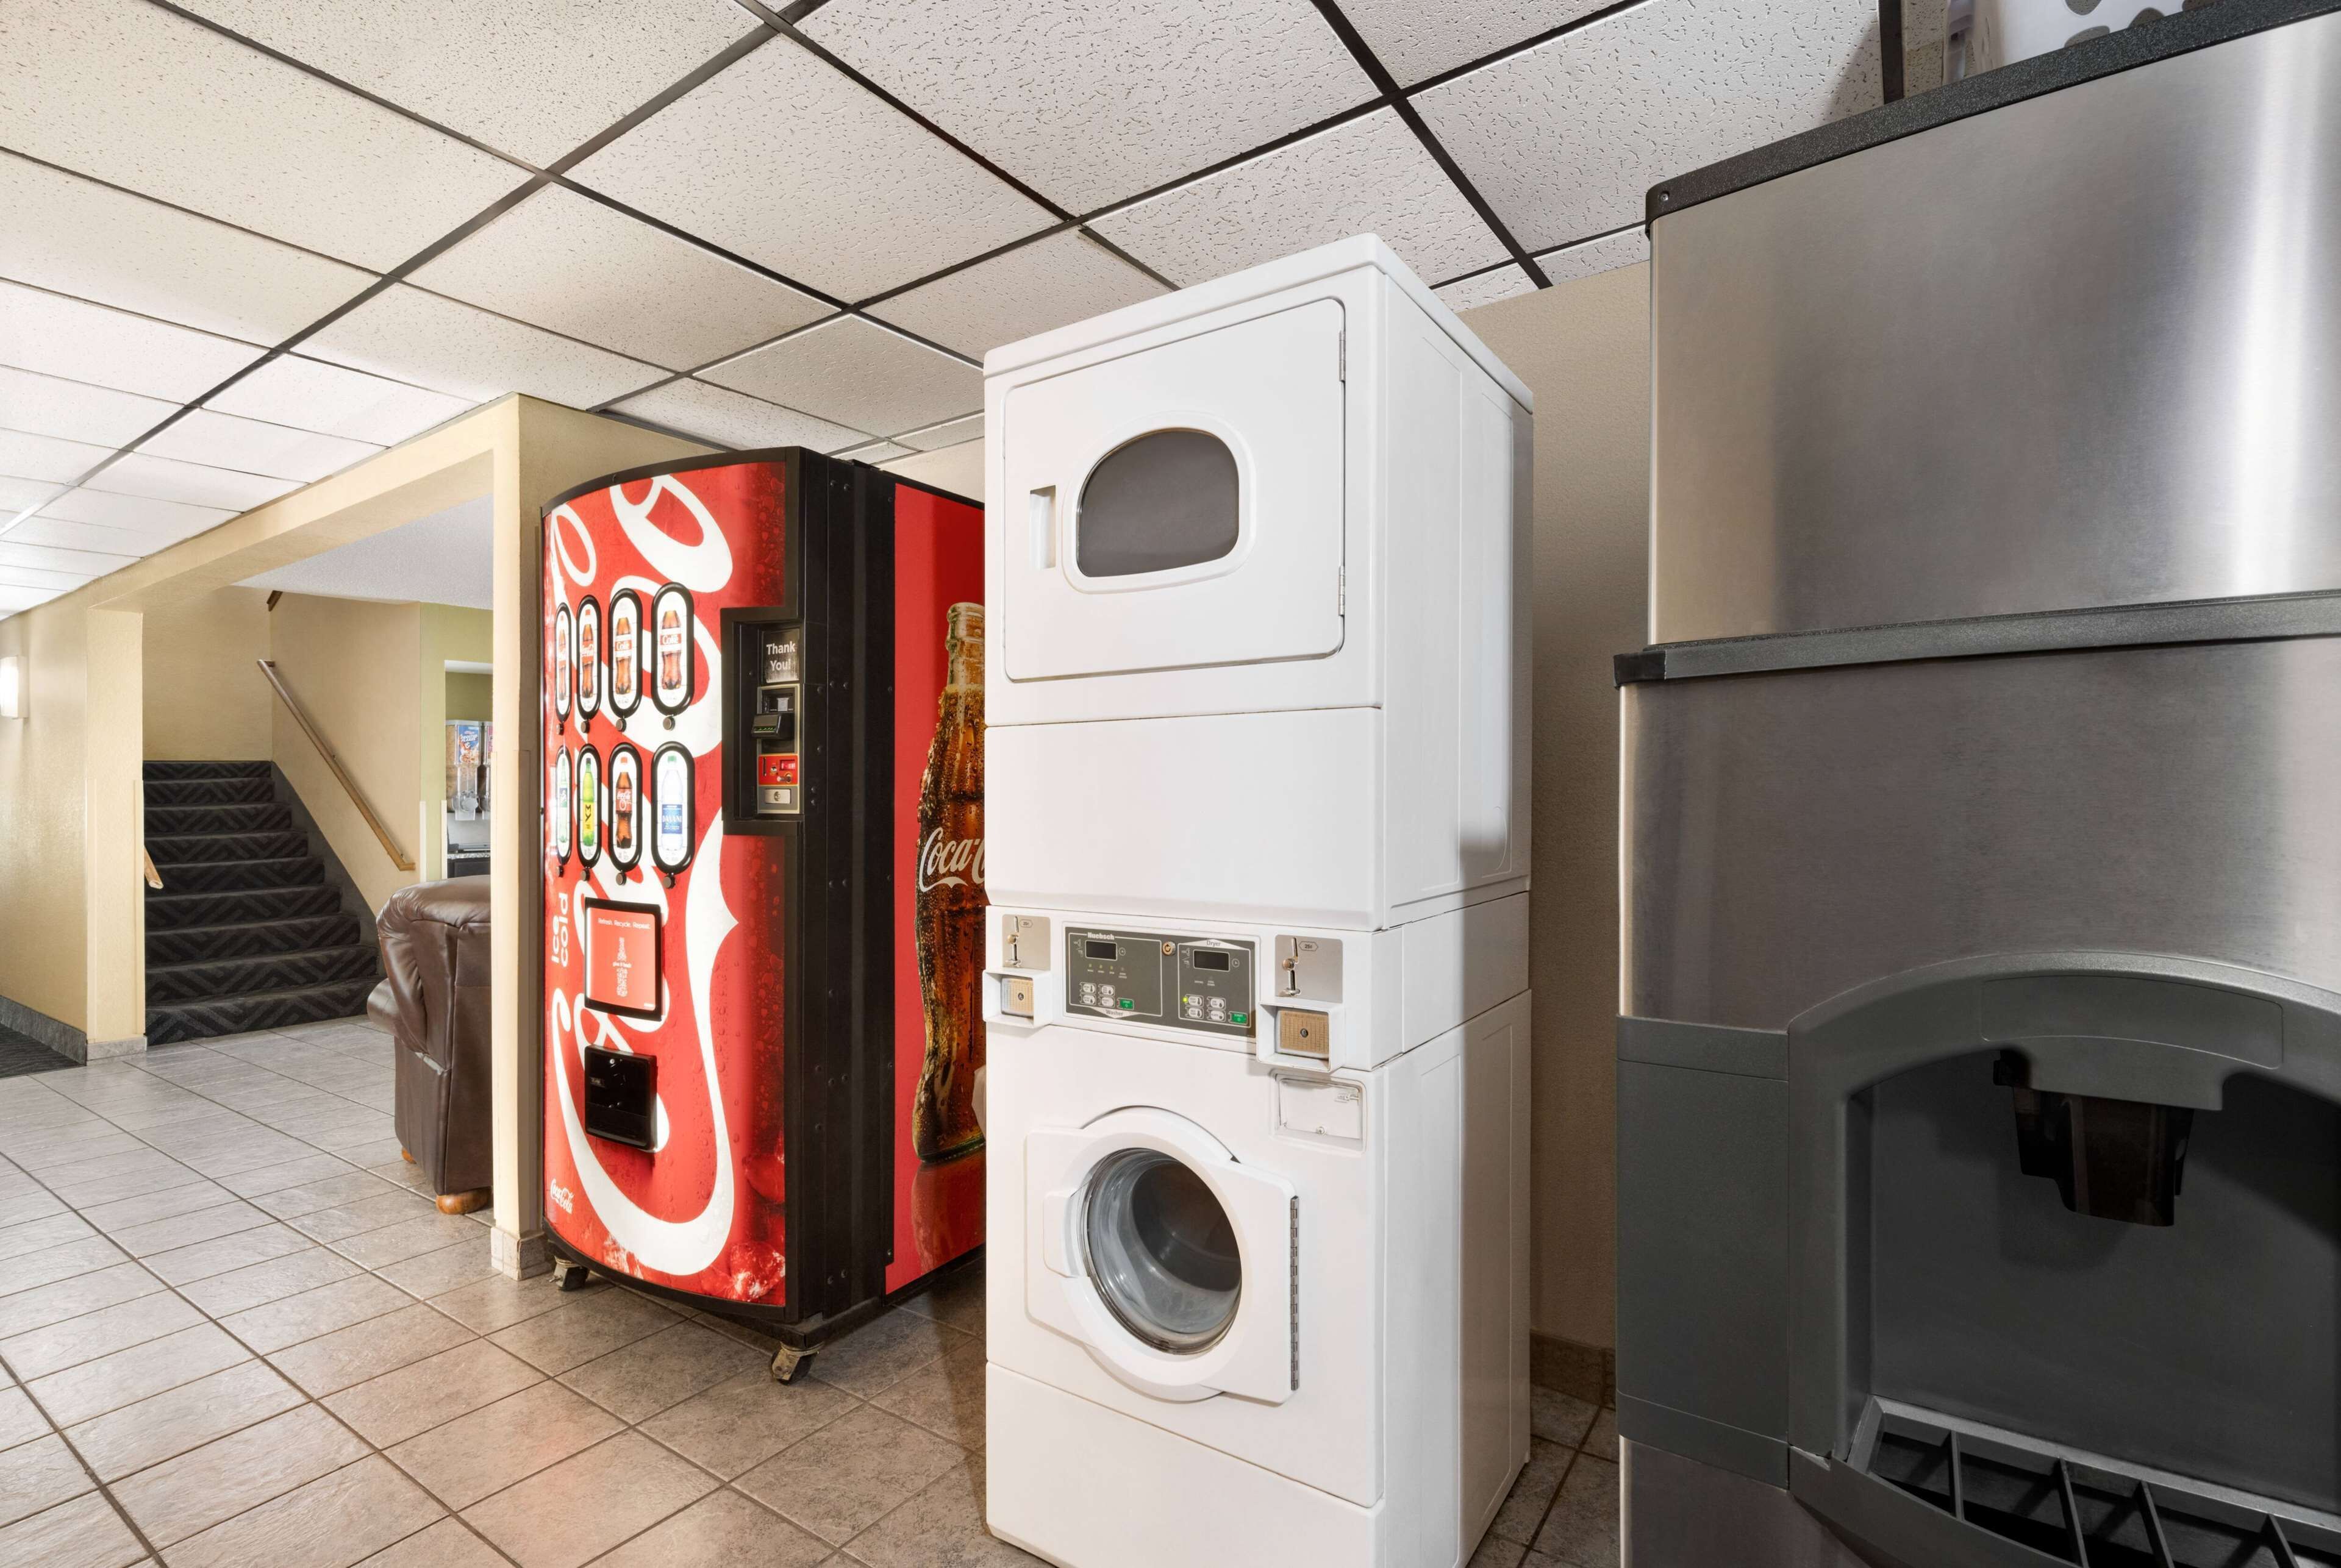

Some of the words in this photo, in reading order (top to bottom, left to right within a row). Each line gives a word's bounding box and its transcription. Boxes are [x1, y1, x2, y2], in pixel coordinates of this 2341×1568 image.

[766, 641, 796, 655] Thank
[770, 658, 792, 671] You!
[558, 892, 569, 968] cold
